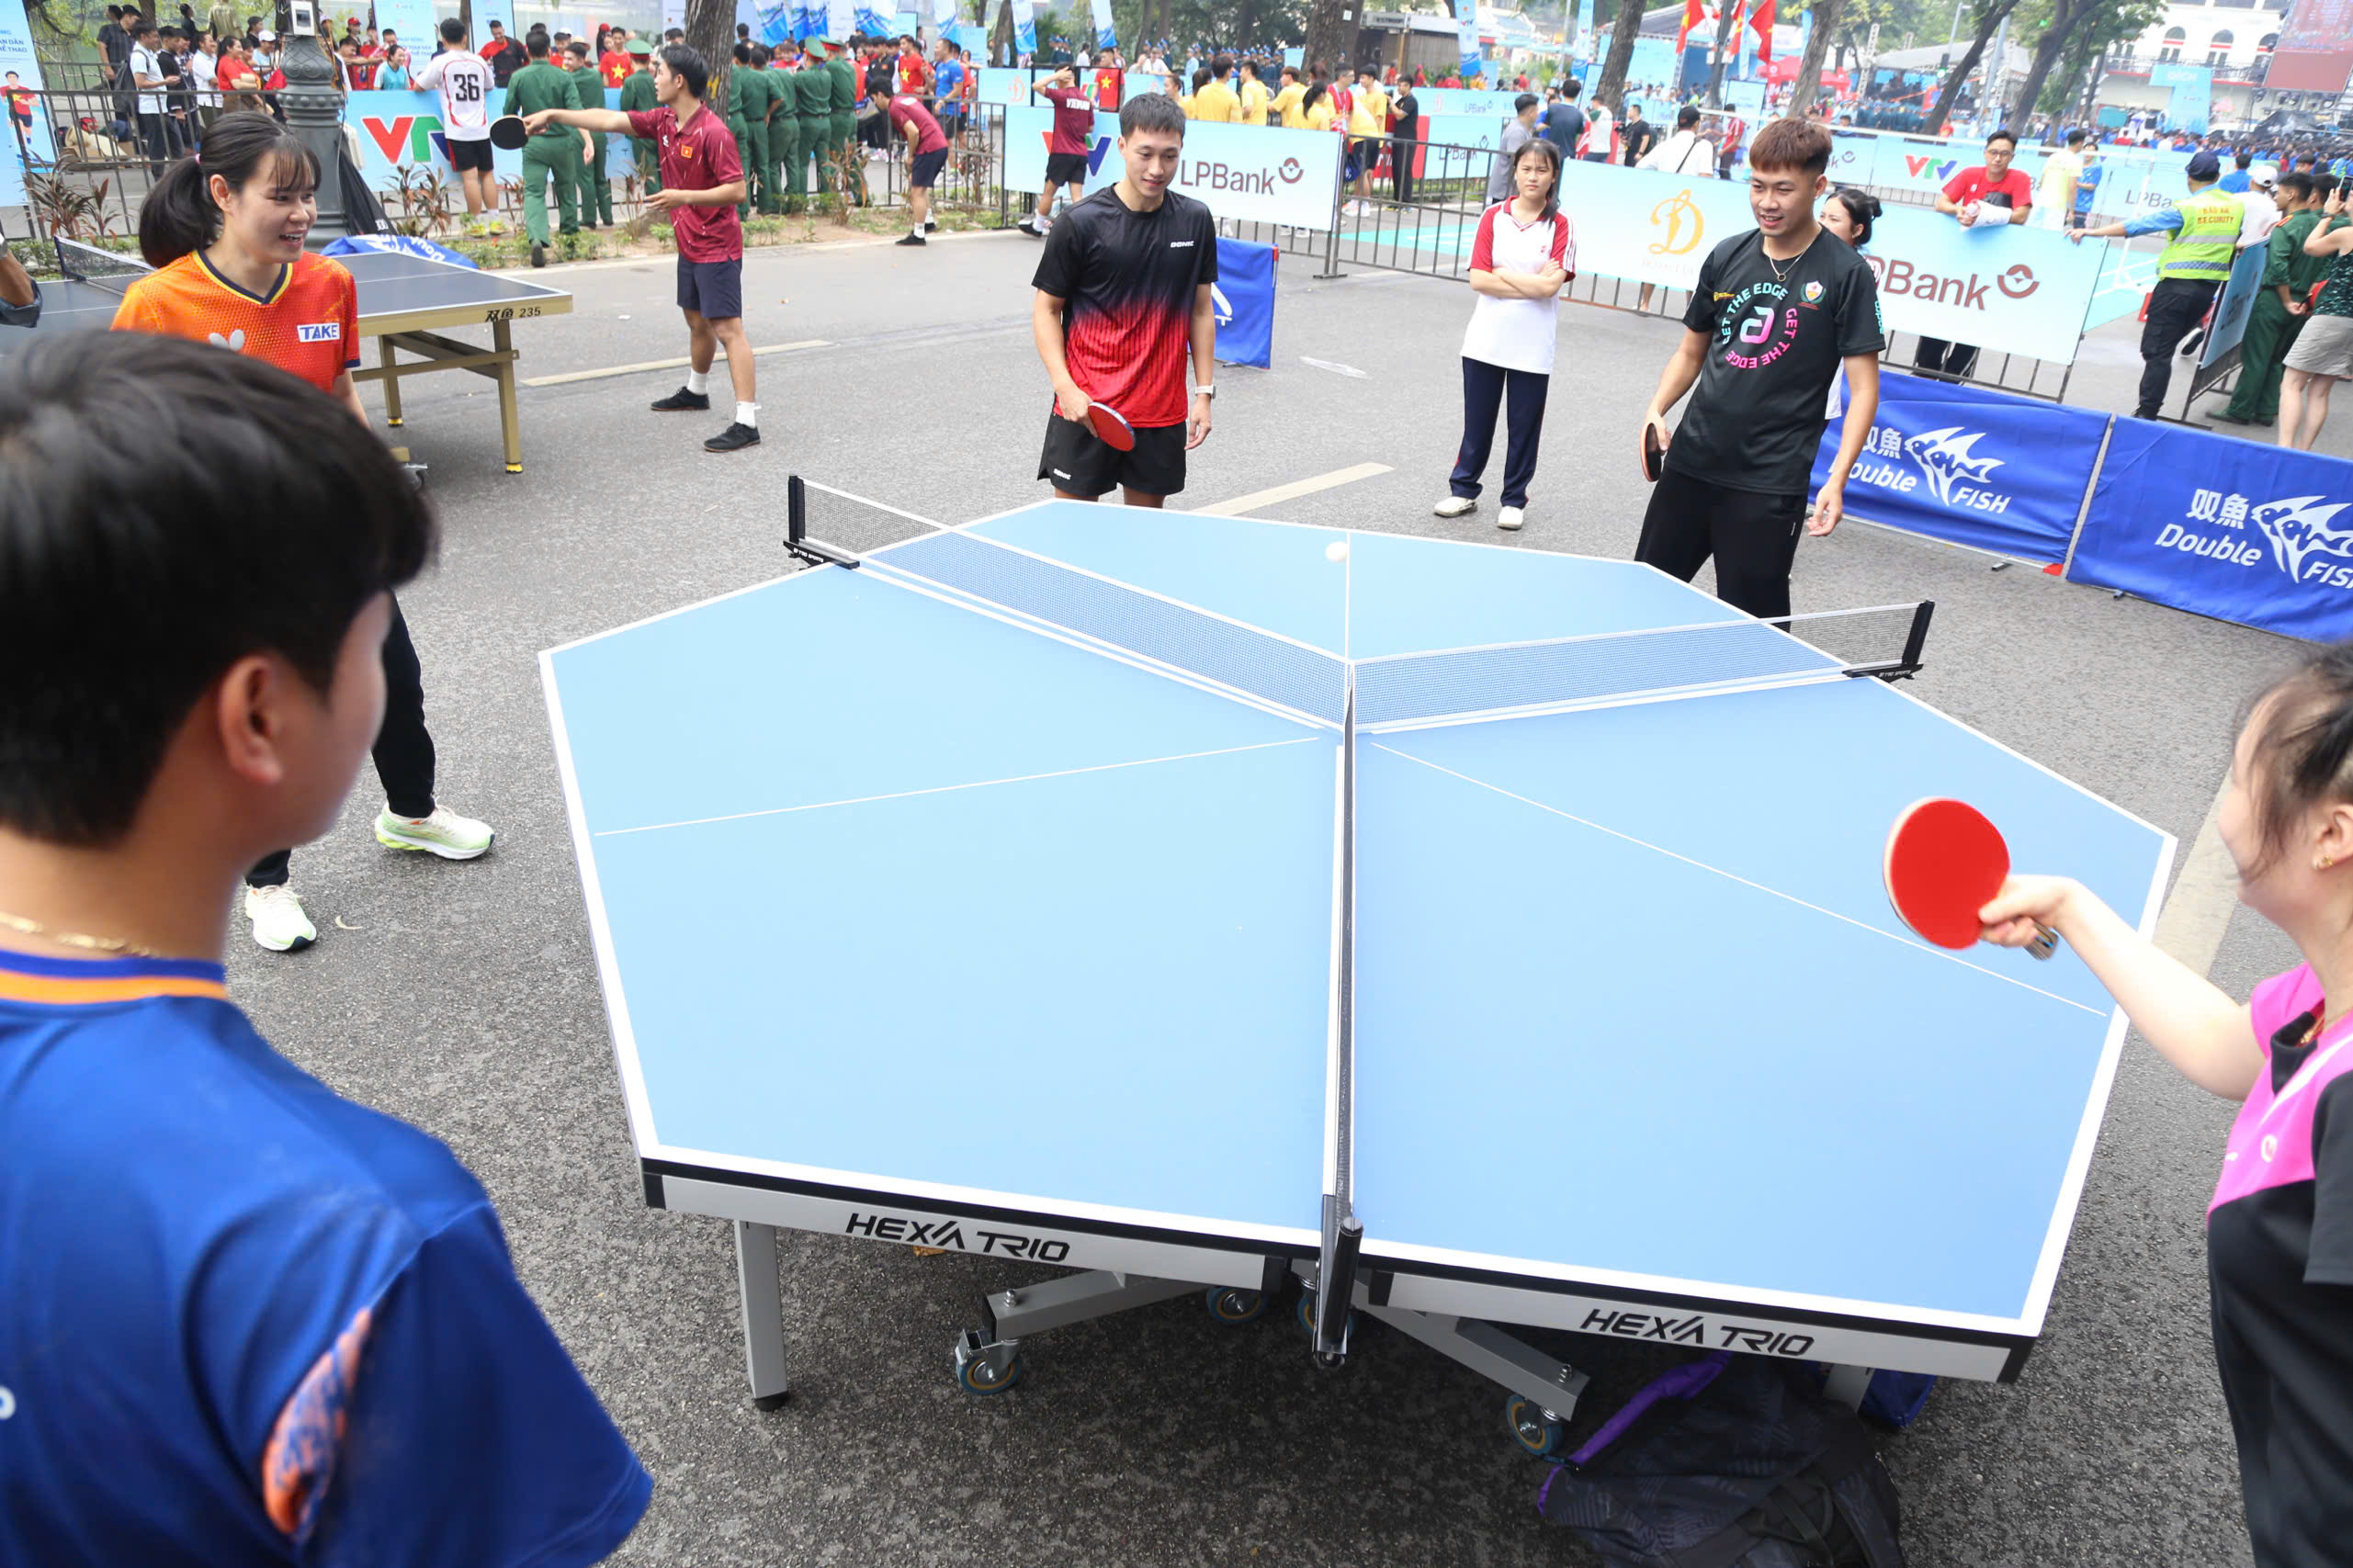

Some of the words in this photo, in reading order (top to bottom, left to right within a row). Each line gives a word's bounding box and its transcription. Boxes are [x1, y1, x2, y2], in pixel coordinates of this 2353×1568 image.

[453, 73, 481, 102] 36
[1181, 159, 1276, 196] LPBank
[1905, 154, 1958, 181] VTV
[2125, 189, 2173, 209] LPBa
[2197, 215, 2234, 224] SECURITY
[1170, 240, 1194, 248] DONIC
[1864, 254, 1992, 310] Bank
[519, 306, 541, 318] 235
[1726, 288, 1752, 314] THE
[1753, 282, 1789, 300] EDGE
[300, 324, 338, 341] TAKE
[1784, 308, 1798, 339] GET
[1725, 350, 1758, 369] EDGE
[1760, 341, 1791, 366] THE
[1830, 455, 1917, 492] ouble
[1951, 486, 2011, 514] FISH
[2186, 489, 2251, 530] 双魚
[2155, 522, 2262, 567] Double
[845, 1213, 966, 1250] HEXA
[976, 1231, 1070, 1262] TRIO
[1578, 1308, 1705, 1345] HEXA
[1720, 1325, 1816, 1358] TRIO
